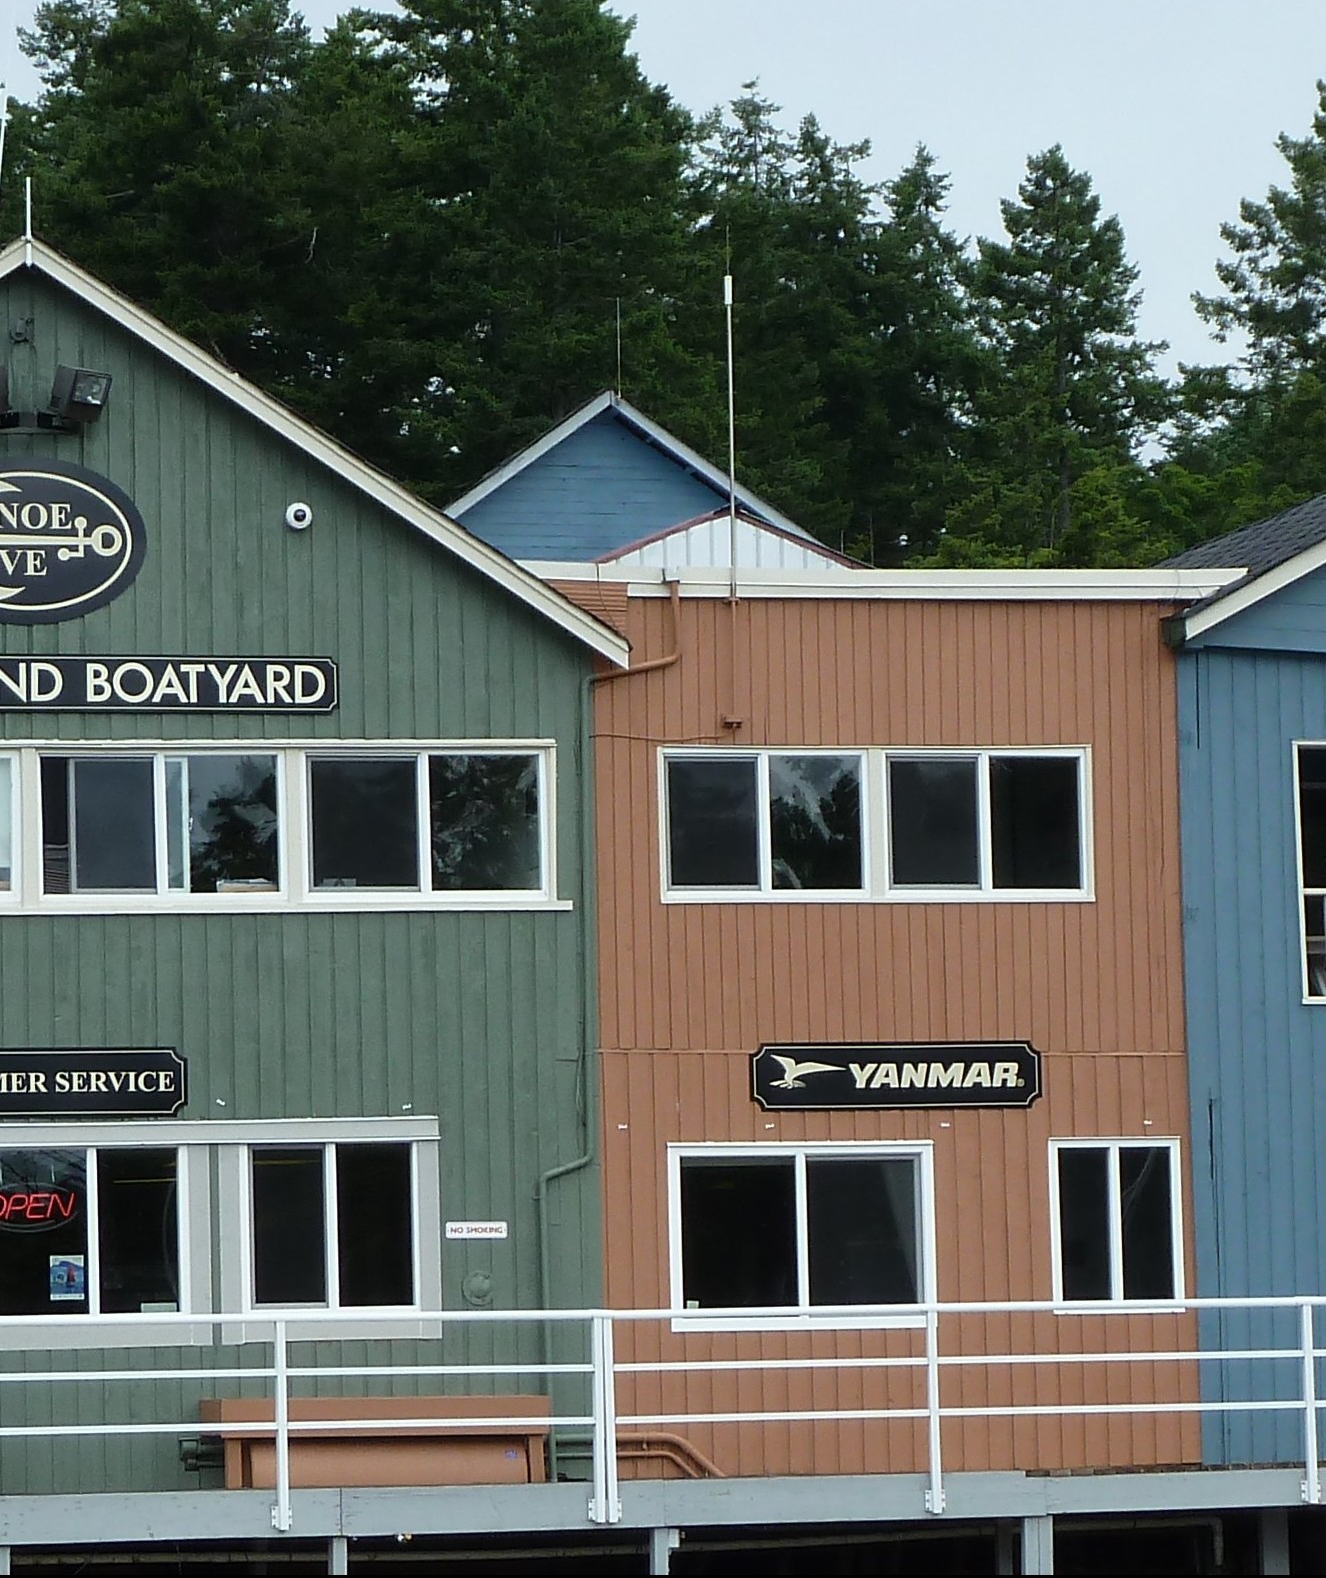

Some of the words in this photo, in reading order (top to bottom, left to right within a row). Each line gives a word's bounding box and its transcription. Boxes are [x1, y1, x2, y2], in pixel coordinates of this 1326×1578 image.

[86, 662, 326, 703] BOATYARD
[55, 1071, 175, 1094] SERVICE
[450, 1226, 464, 1234] NO
